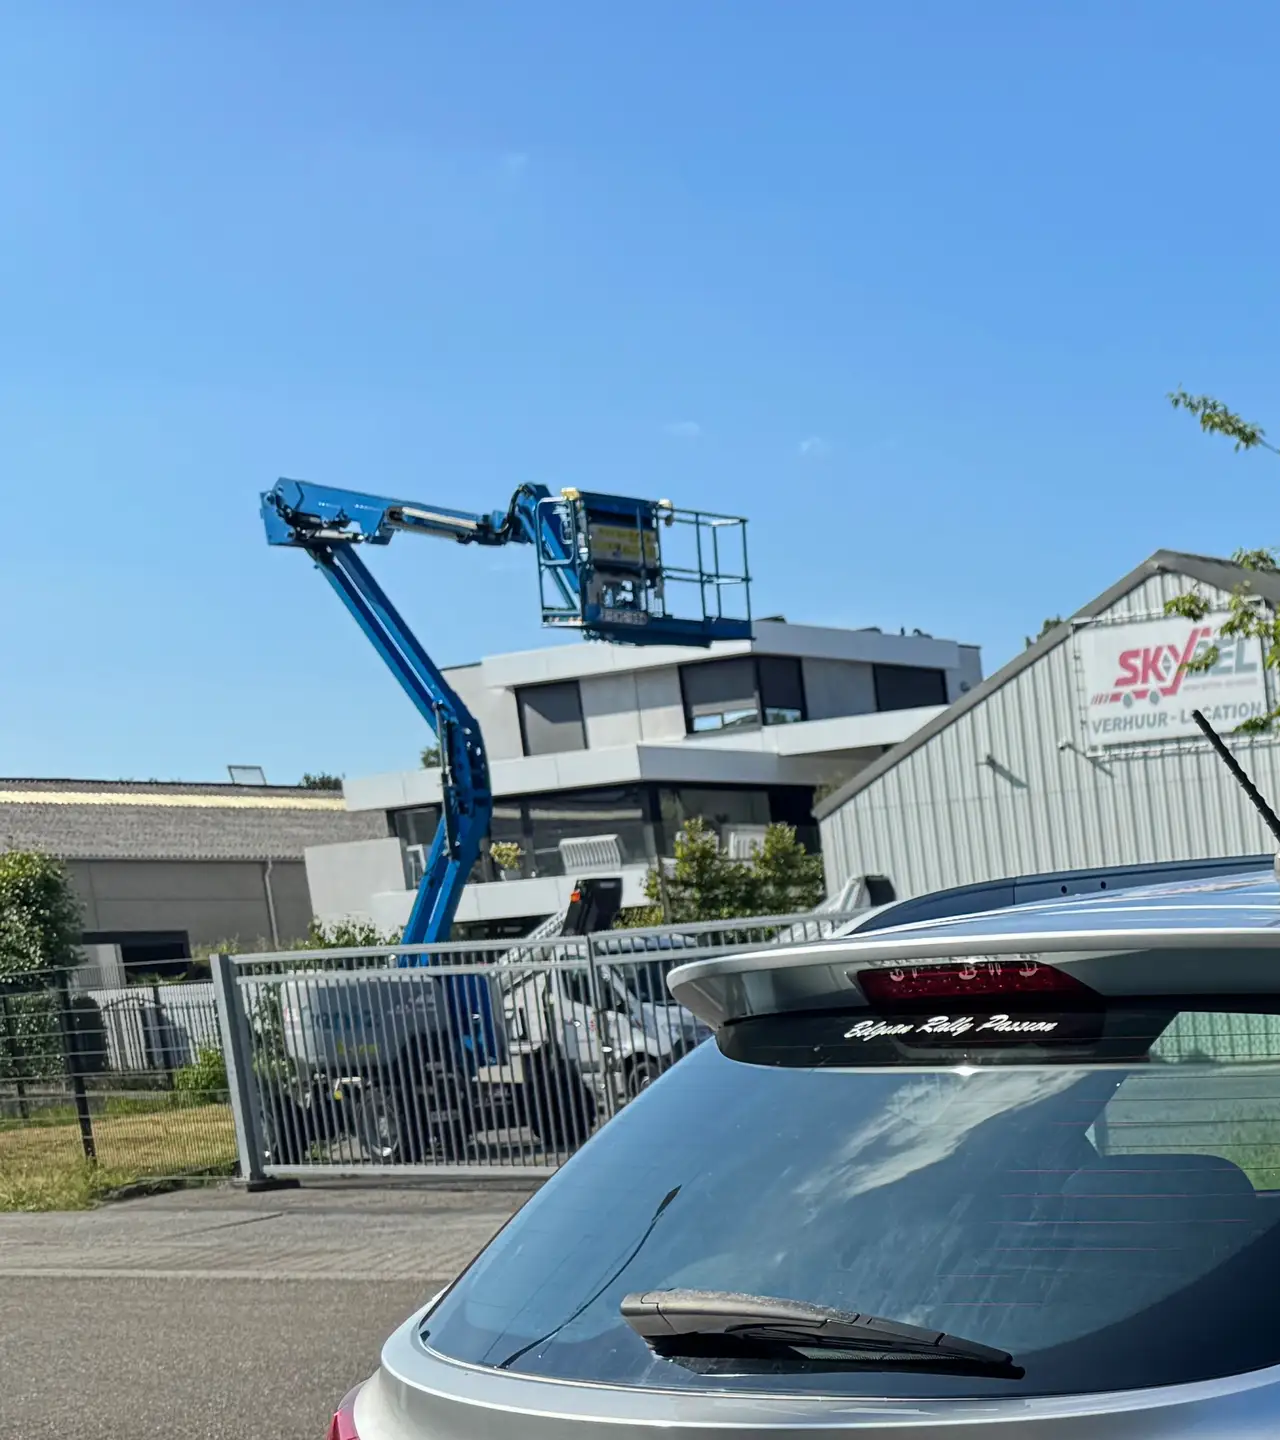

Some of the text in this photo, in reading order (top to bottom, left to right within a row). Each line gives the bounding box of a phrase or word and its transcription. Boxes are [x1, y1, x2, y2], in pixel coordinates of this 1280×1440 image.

[1092, 713, 1168, 735] VERHUUR
[1180, 701, 1262, 726] LCATION
[916, 1015, 975, 1037] Rally
